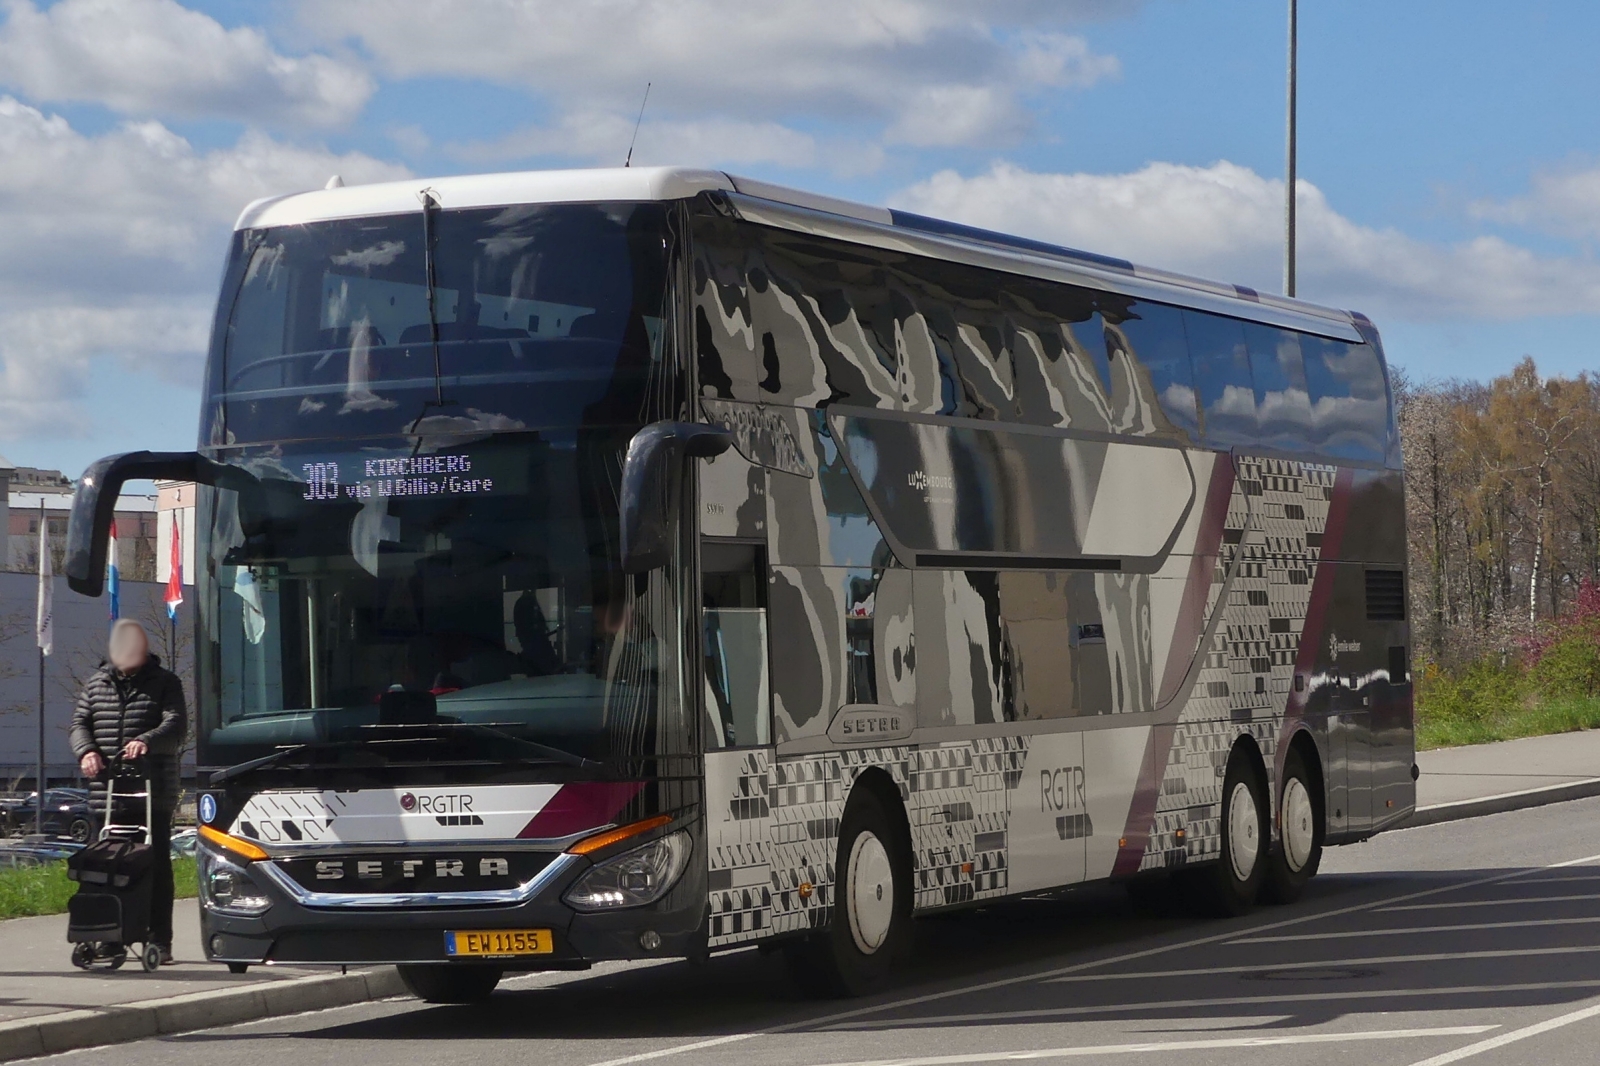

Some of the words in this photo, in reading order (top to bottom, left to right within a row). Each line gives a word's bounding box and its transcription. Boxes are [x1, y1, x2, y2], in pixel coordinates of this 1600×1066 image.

[365, 455, 471, 477] KIRCHBERG
[303, 462, 338, 500] 303
[345, 481, 371, 498] via
[908, 470, 953, 490] LUXEMBOURG
[843, 717, 900, 734] SETRA
[1040, 766, 1085, 813] RGTR
[418, 794, 473, 814] RGTR
[315, 858, 509, 880] SETRA
